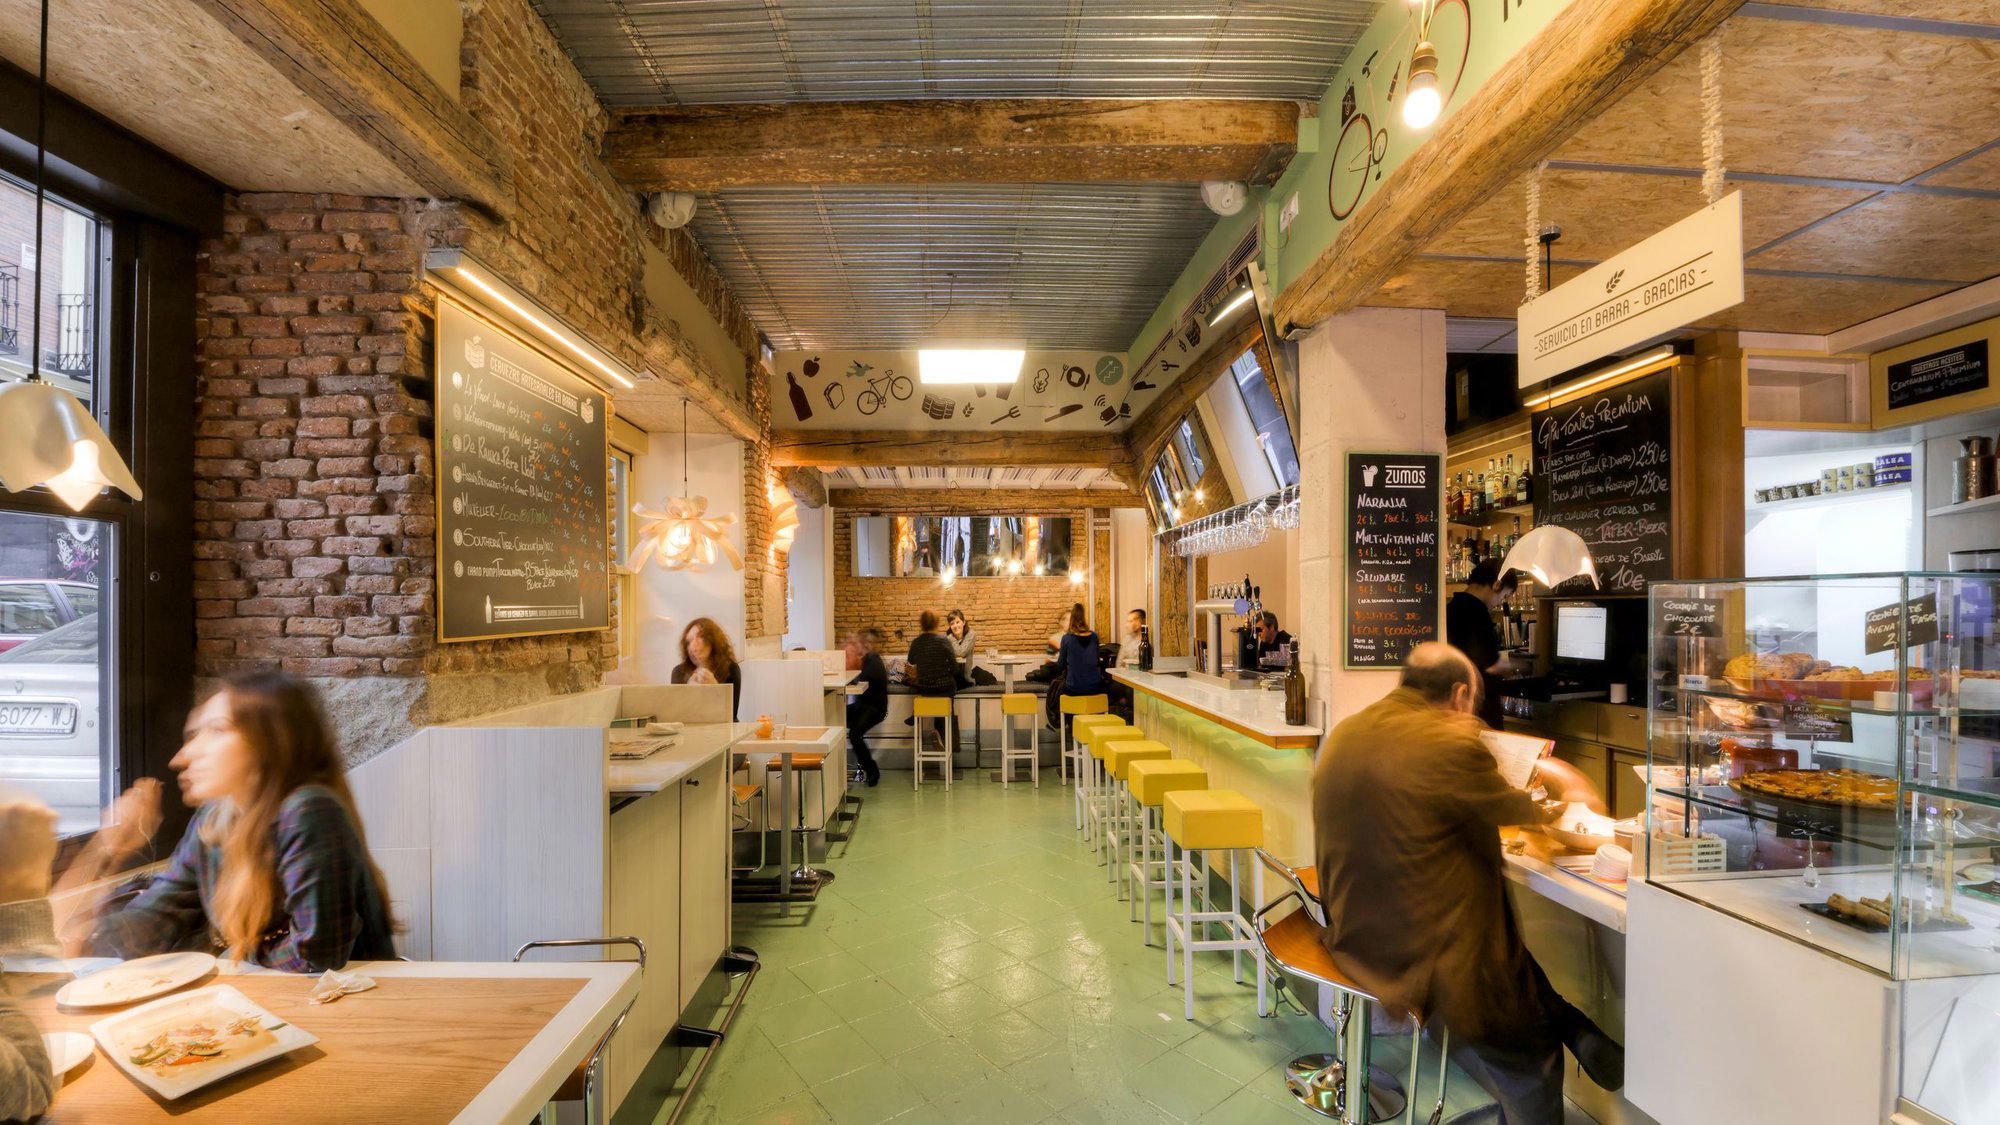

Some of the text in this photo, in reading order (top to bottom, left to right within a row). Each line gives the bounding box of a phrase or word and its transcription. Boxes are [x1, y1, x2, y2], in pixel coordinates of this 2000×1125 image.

[1580, 316, 1592, 334] EN
[1595, 299, 1630, 328] BARRA
[1644, 269, 1696, 305] GRACIAS
[1385, 469, 1426, 485] ZUMOS
[1357, 493, 1408, 509] NARANJA
[1642, 502, 1656, 512] DE
[1617, 555, 1630, 563] DE
[1356, 569, 1406, 584] SALUDABLE
[1610, 565, 1645, 591] 10€
[1704, 604, 1716, 612] DE
[1664, 613, 1716, 623] CHOCOLATE
[1867, 613, 1938, 634] AVENA PASAS
